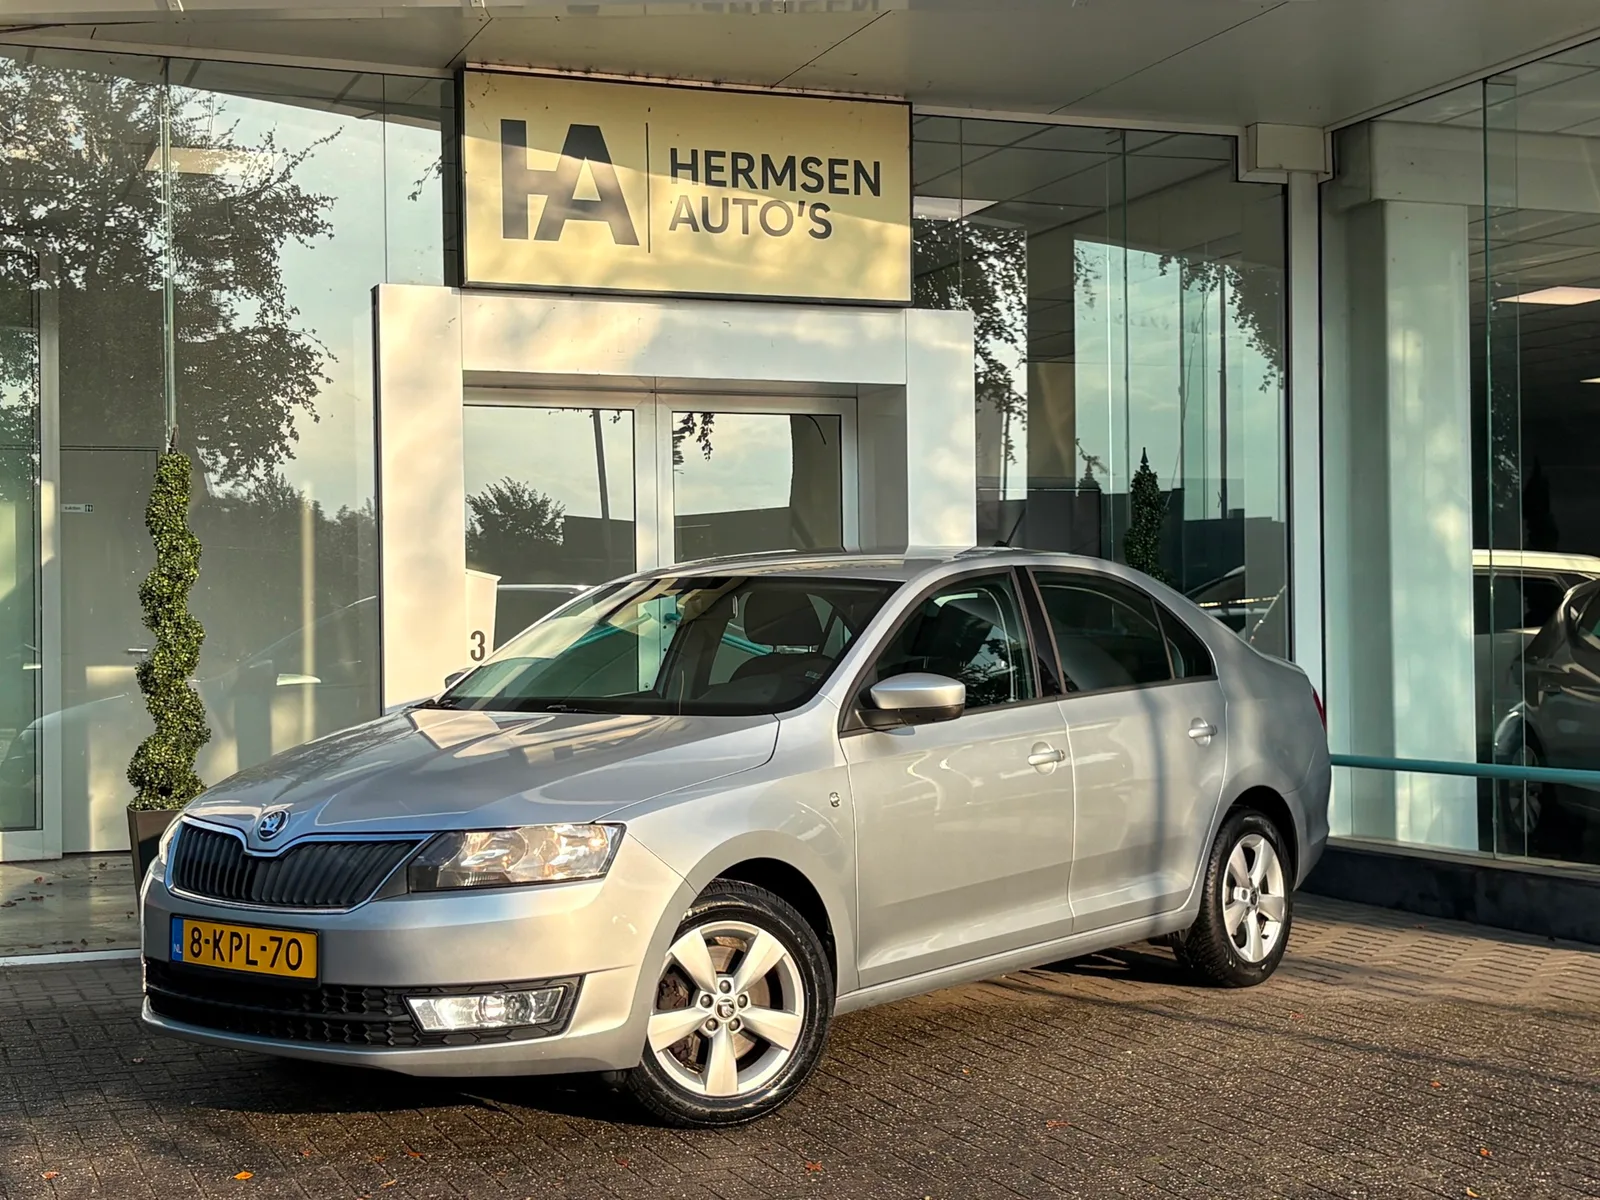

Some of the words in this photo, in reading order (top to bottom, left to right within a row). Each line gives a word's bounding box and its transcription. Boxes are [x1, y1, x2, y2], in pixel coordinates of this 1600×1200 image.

[670, 148, 881, 197] HERMSEN
[669, 195, 832, 240] AUTO'S
[470, 630, 485, 661] 3
[173, 943, 182, 954] NL
[190, 926, 303, 971] 8-KPL-70
